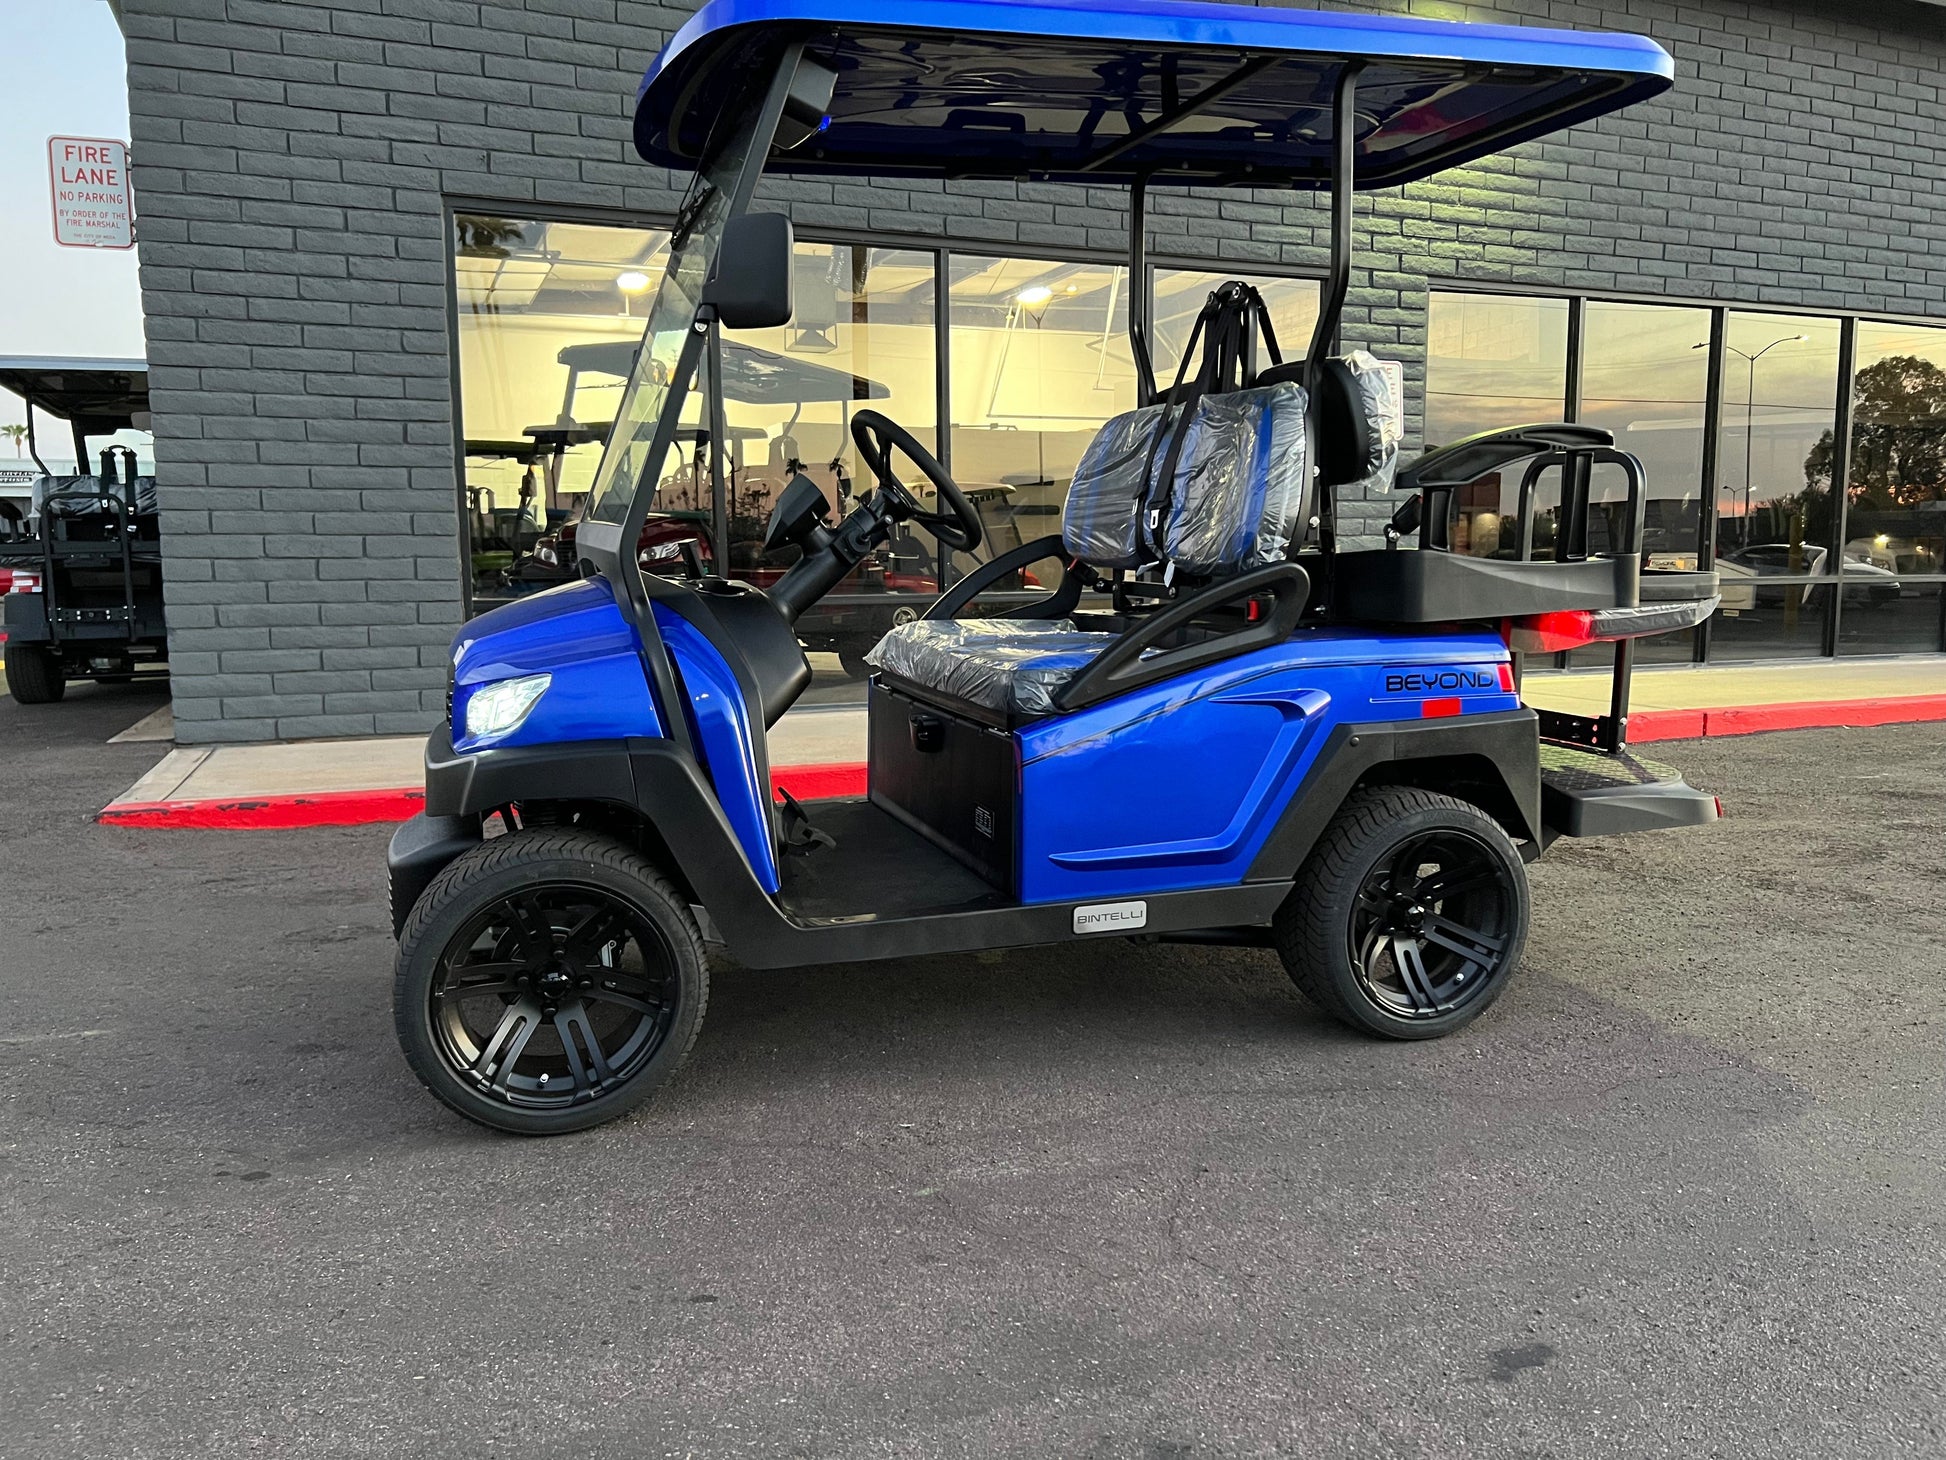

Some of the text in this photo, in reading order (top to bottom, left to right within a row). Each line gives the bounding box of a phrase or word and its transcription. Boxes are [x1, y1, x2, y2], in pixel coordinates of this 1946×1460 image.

[64, 144, 112, 164] FIRE
[61, 166, 119, 186] LANE
[59, 191, 123, 205] NO PARKING
[59, 209, 126, 220] BY ORDER OF THE
[66, 218, 121, 229] FIRE MARSHAL
[1386, 671, 1494, 692] BEYOND
[1077, 910, 1143, 925] BINTELLI
